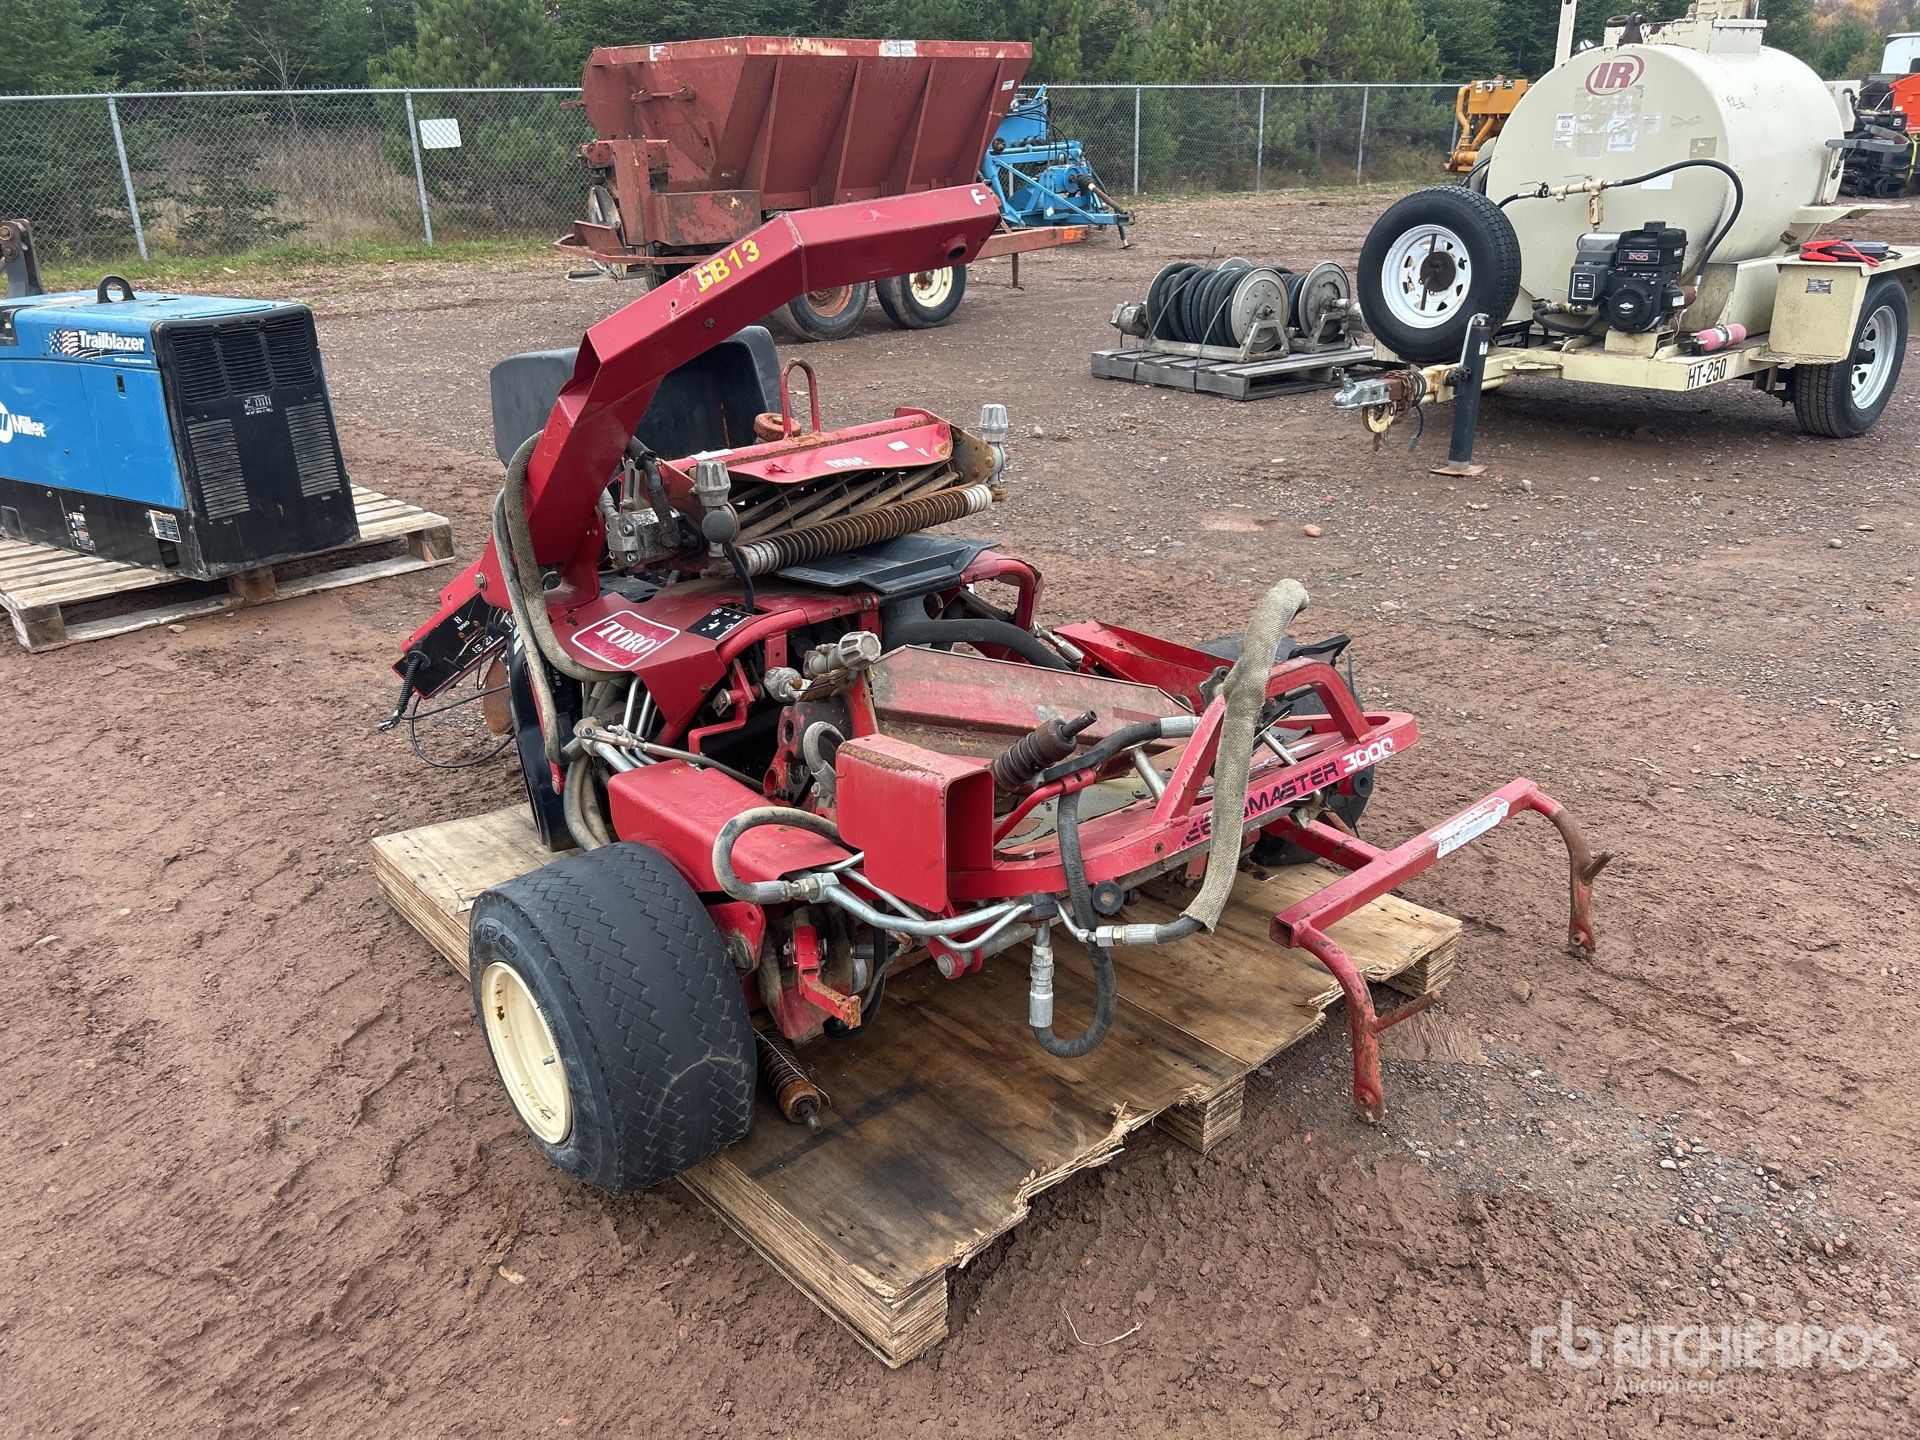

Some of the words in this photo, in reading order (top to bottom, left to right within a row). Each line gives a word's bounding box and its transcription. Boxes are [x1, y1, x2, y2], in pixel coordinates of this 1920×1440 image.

[1593, 62, 1635, 89] IR
[78, 329, 145, 352] Trailblazer
[1686, 357, 1727, 390] HT-250
[9, 413, 47, 438] Miller
[594, 619, 658, 654] TORO
[1341, 736, 1396, 774] 3000
